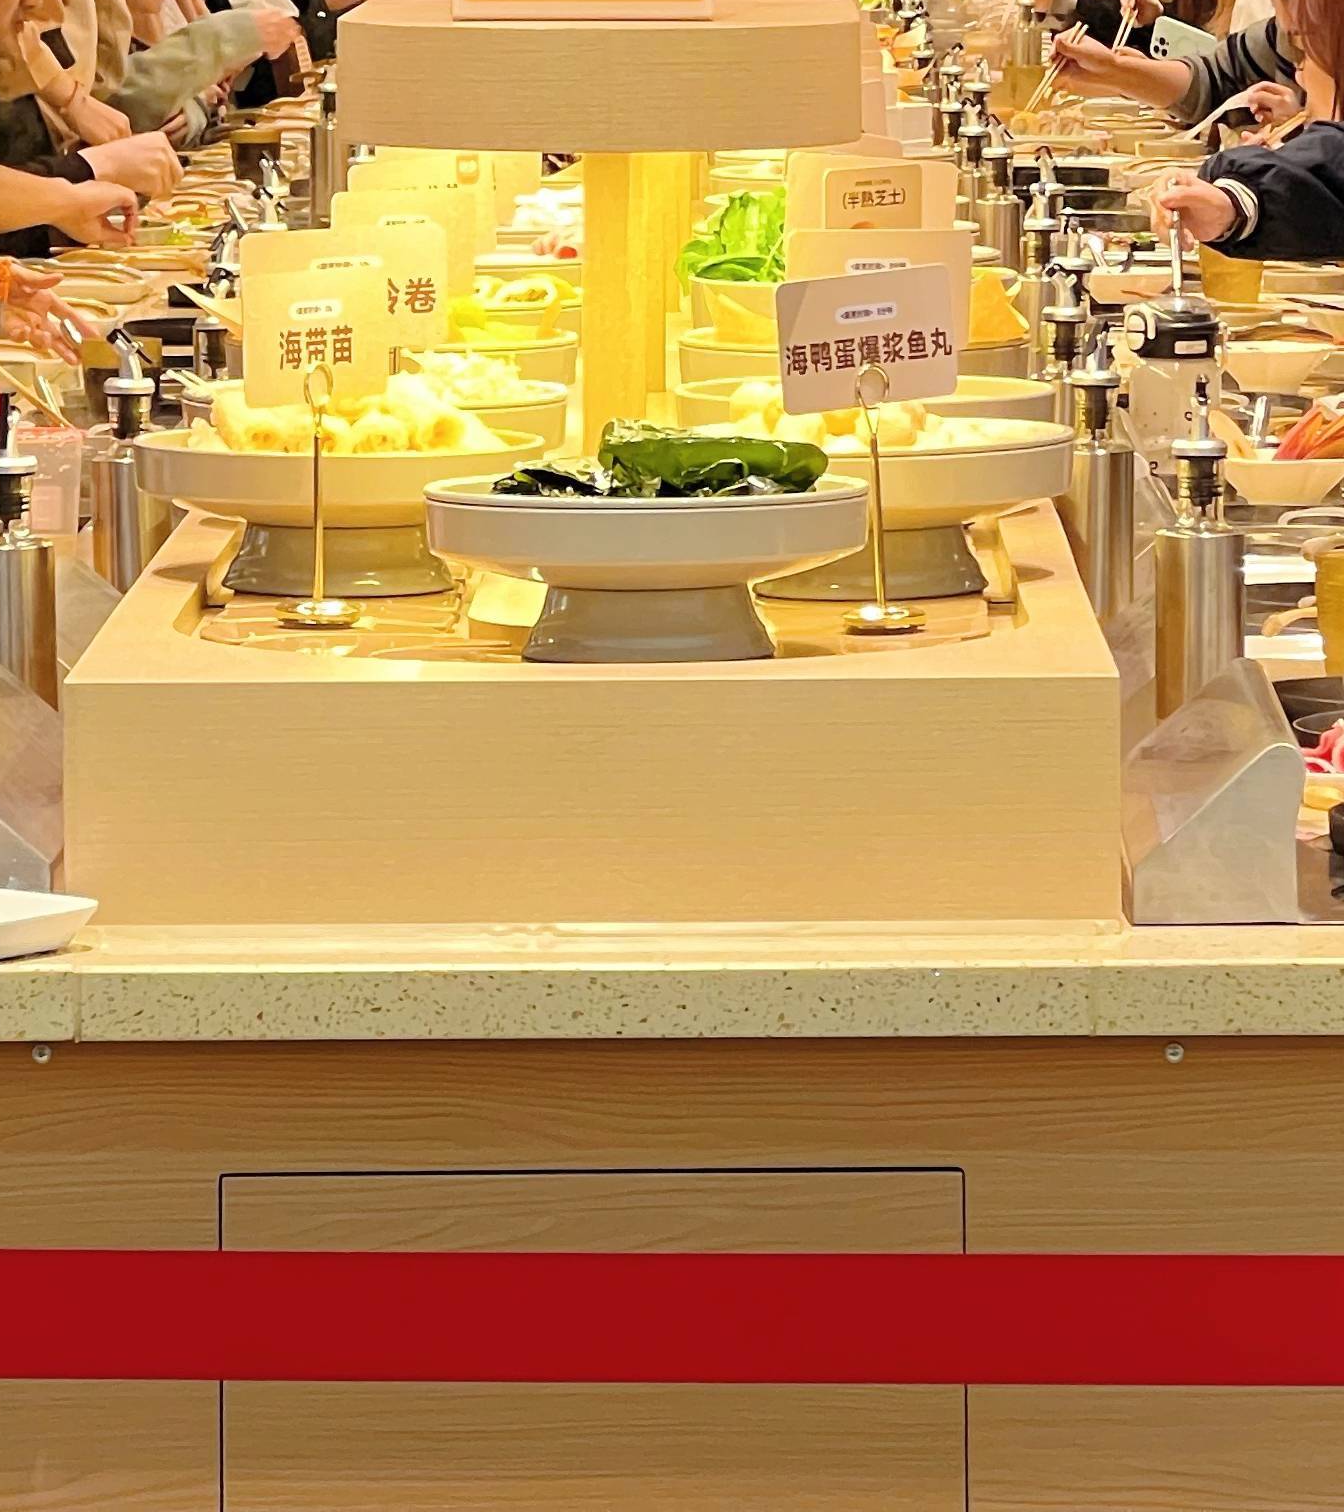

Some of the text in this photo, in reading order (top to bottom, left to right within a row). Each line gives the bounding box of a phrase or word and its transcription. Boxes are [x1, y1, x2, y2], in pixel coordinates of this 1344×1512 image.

[279, 325, 353, 370] 海带苗
[785, 327, 953, 376] 海鸭蛋爆浆鱼丸
